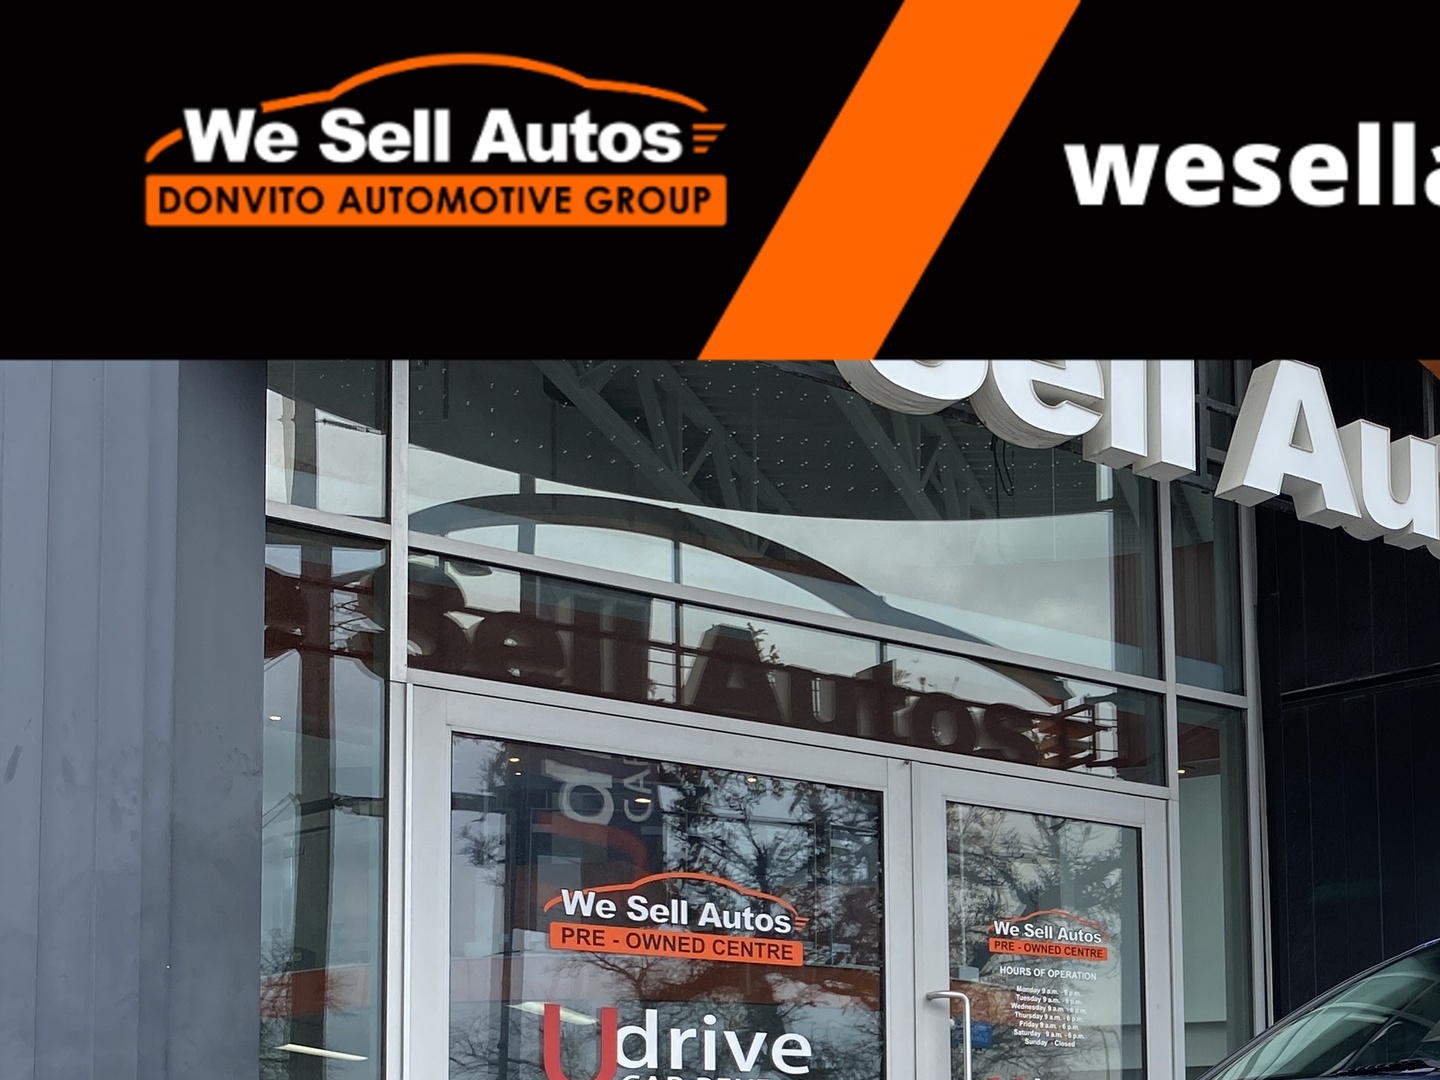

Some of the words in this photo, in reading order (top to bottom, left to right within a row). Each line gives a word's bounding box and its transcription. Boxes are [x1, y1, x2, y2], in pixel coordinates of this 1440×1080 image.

[560, 888, 617, 919] We
[626, 894, 689, 927] Sell
[698, 901, 792, 935] Autos
[993, 920, 1020, 937] We
[1024, 923, 1053, 940] Sell
[1057, 927, 1103, 944] Autos
[560, 926, 606, 947] PRE
[624, 930, 706, 956] OWNED
[711, 937, 794, 962] CENTRE
[994, 940, 1015, 952] PRE
[1023, 944, 1062, 956] OWNED
[1063, 946, 1104, 959] CENTRE
[999, 965, 1032, 978] HOURS
[1034, 968, 1046, 978] OF
[1047, 968, 1098, 981] OPERATION
[1016, 986, 1041, 995] Monday
[1016, 994, 1042, 1003] Tuesday
[1011, 1003, 1046, 1012] Wednesday
[1015, 1012, 1043, 1021] Thursday
[1019, 1020, 1039, 1029] Friday
[1013, 1029, 1041, 1038] Saturday
[1024, 1037, 1048, 1047] Sunday
